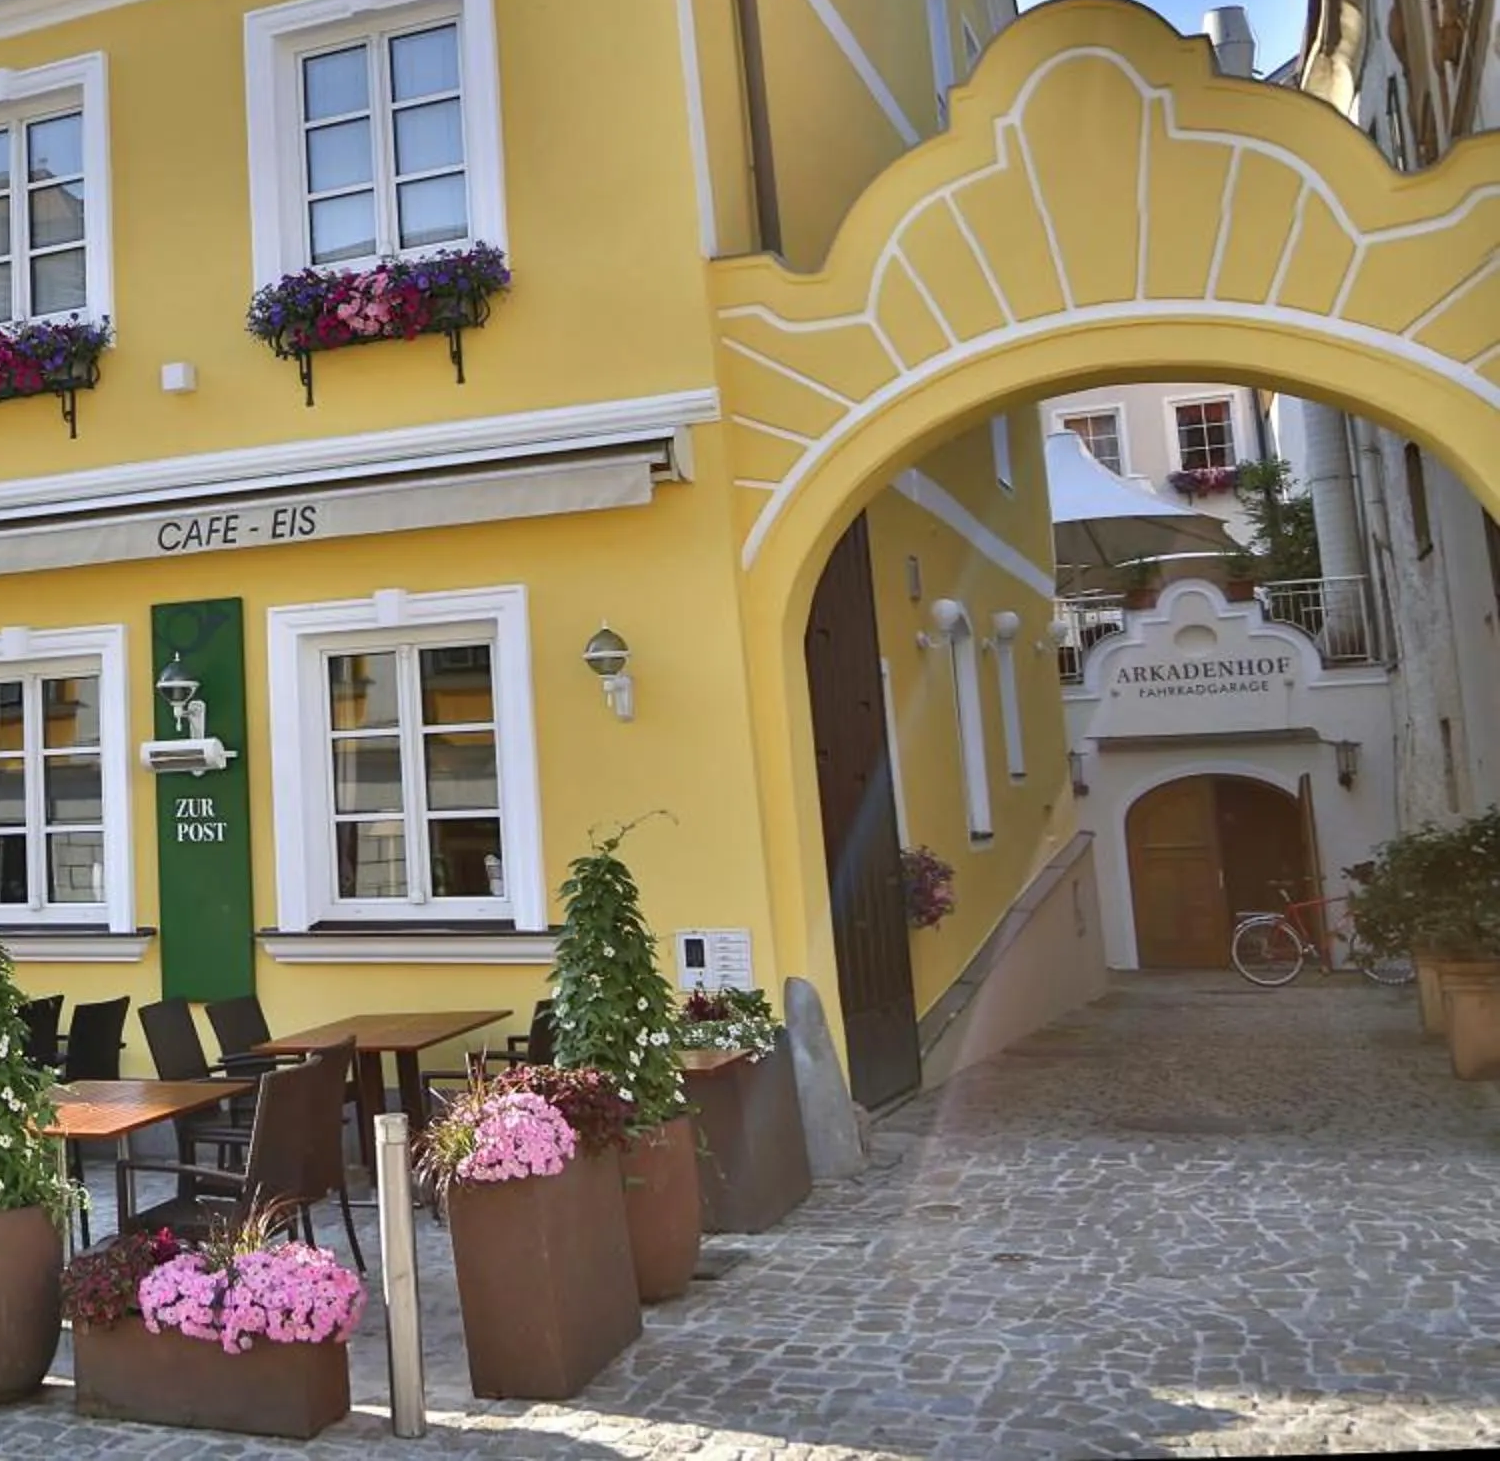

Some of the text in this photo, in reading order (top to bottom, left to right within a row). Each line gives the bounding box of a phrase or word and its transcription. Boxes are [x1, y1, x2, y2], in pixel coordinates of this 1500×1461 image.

[157, 514, 240, 551] CAFE
[271, 505, 317, 539] EIS
[1117, 656, 1292, 684] ARKADENHOF
[176, 798, 216, 818] ZUR
[177, 822, 228, 842] POST
